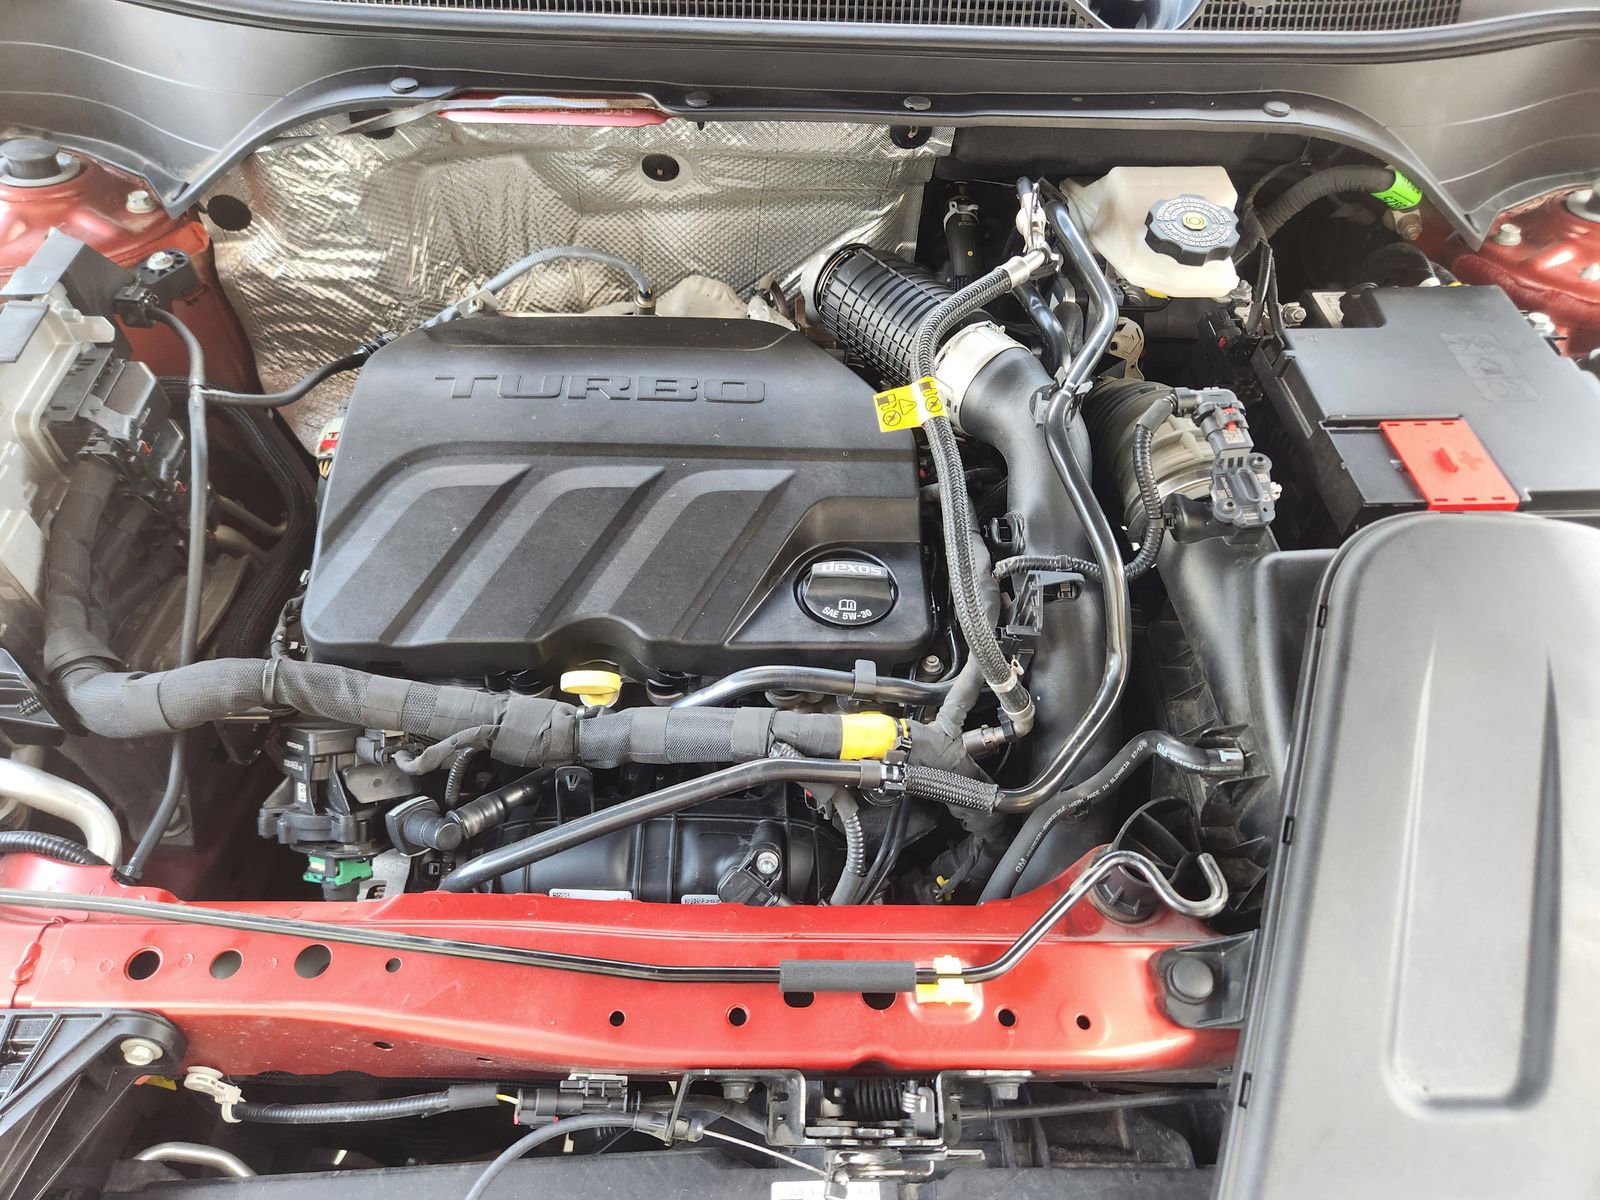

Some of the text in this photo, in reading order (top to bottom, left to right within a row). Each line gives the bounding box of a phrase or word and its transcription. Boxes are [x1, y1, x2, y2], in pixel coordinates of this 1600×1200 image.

[434, 374, 766, 404] TURBO
[822, 561, 881, 575] dexos
[822, 606, 873, 621] SAE 5W-30
